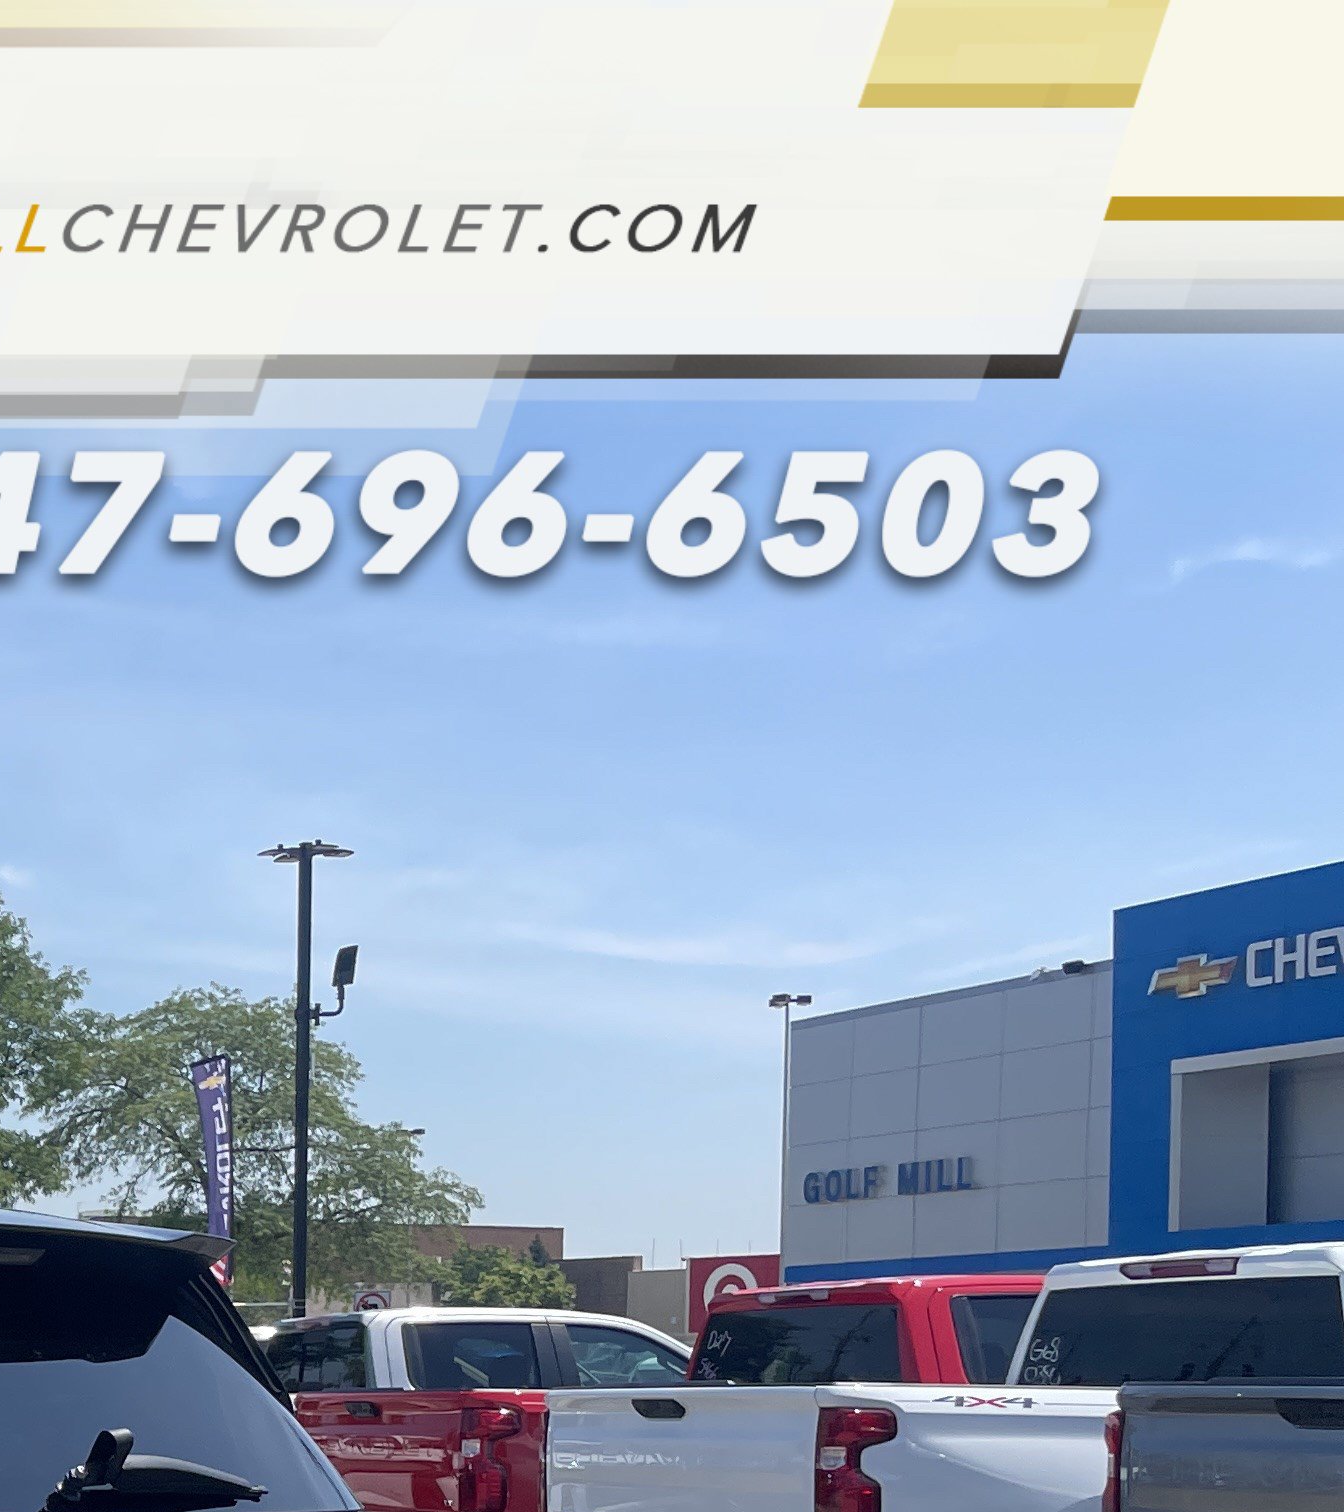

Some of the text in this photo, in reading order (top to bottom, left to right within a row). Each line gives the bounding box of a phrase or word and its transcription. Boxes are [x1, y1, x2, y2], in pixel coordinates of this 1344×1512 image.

[1246, 926, 1344, 987] CHE
[803, 1157, 974, 1204] GOLF MILL
